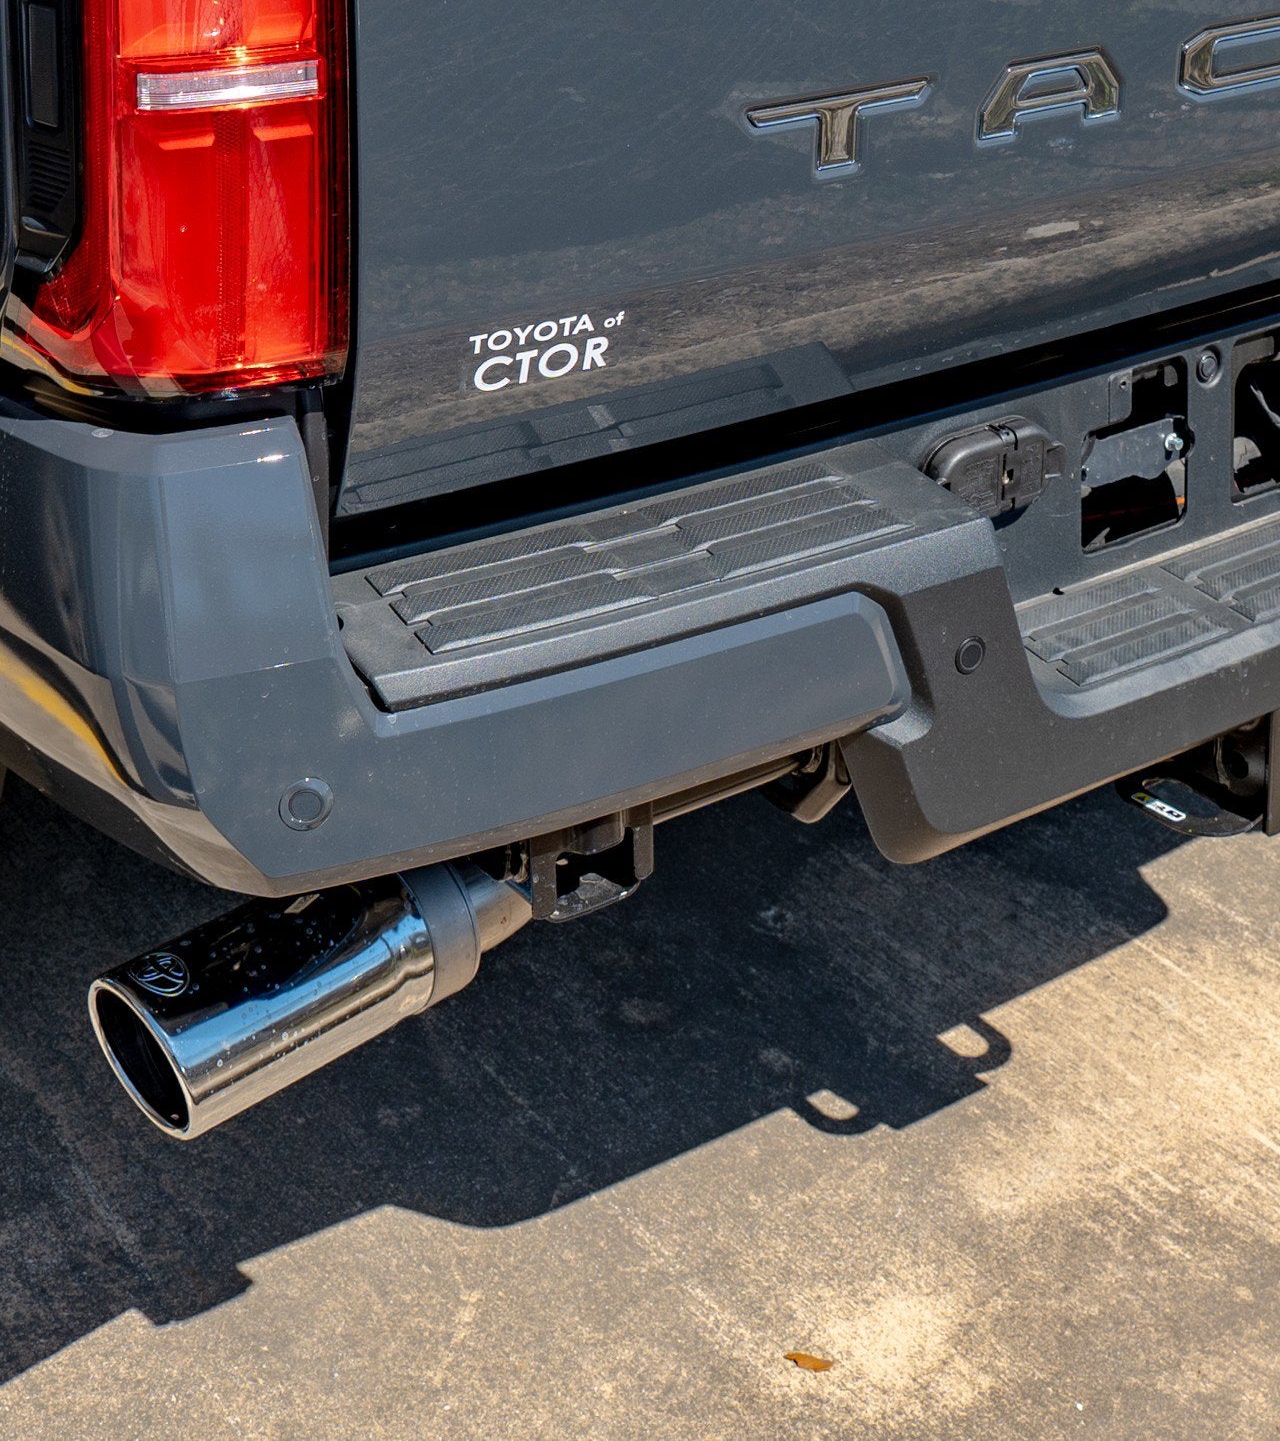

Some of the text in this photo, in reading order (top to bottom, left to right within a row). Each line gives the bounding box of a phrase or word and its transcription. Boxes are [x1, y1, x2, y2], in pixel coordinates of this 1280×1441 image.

[469, 310, 625, 355] TOYOTA of
[473, 336, 609, 392] CTOR
